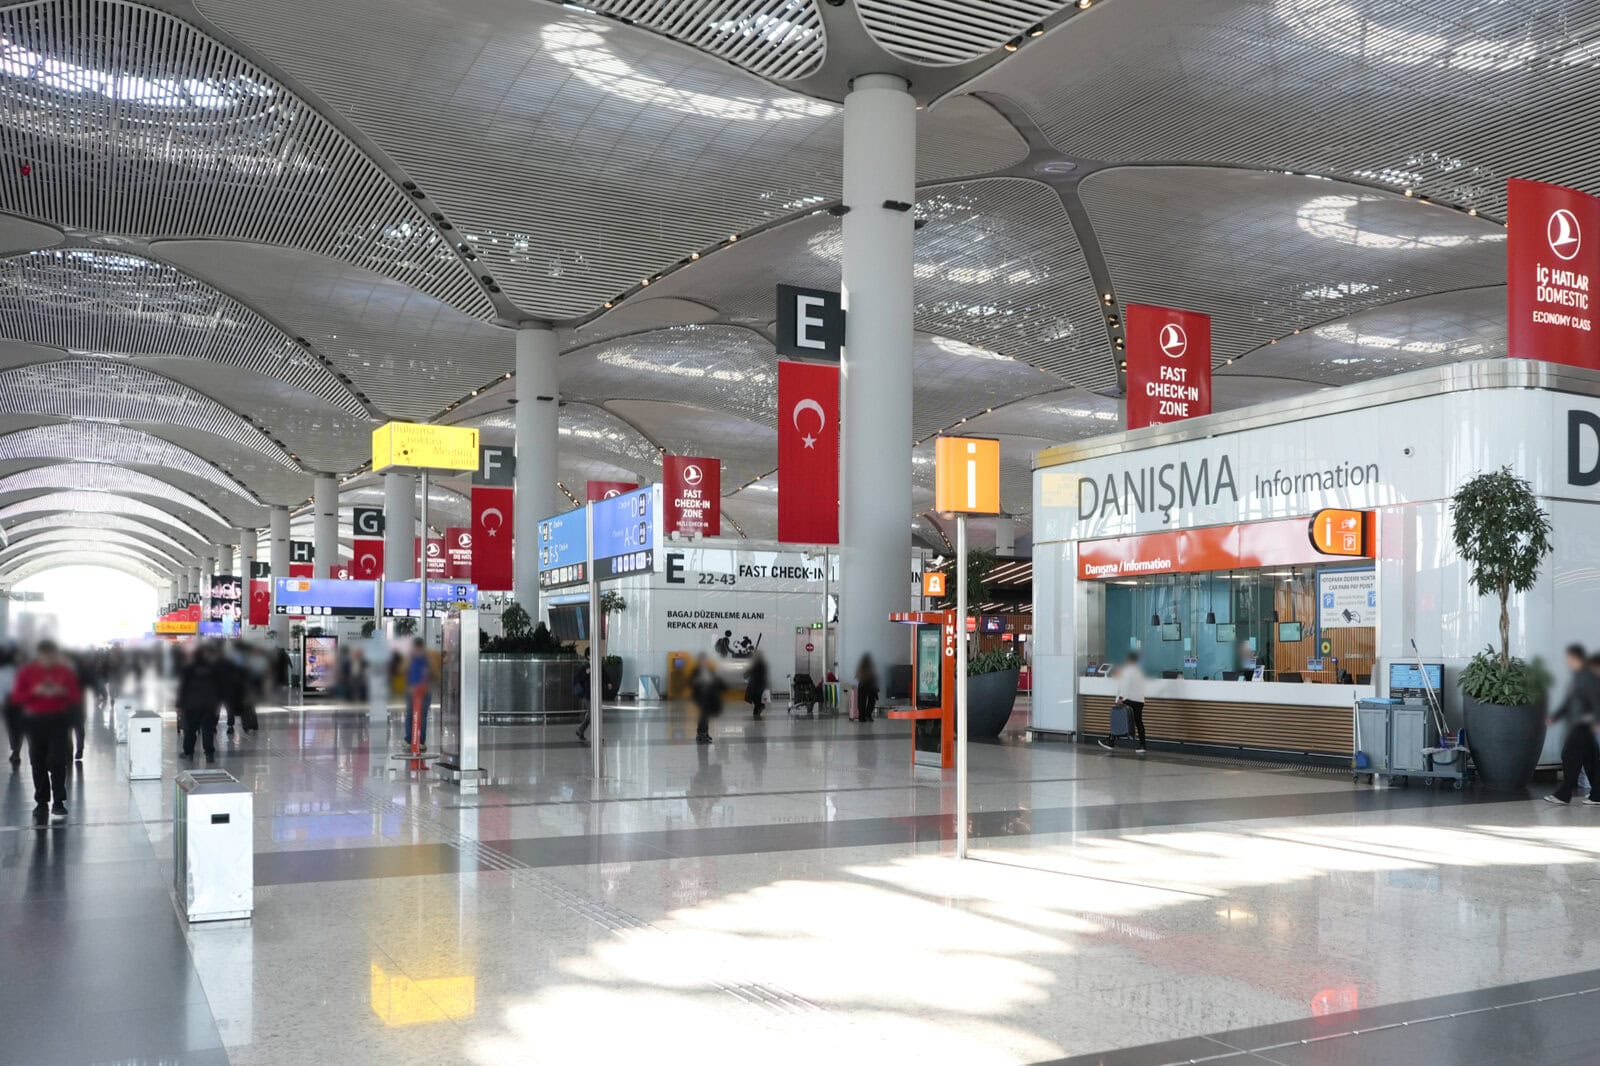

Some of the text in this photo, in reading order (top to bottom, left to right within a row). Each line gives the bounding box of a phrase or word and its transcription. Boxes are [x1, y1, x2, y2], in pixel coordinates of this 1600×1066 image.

[1536, 263, 1589, 291] İÇ HATLAR
[1537, 286, 1589, 309] DOMESTIC
[796, 294, 825, 350] E
[1532, 311, 1591, 331] ECONOMY CLASS
[1160, 365, 1187, 382] FAST
[1146, 382, 1199, 401] CHECK-IN
[1159, 400, 1189, 417] ZONE
[1568, 410, 1600, 487] D
[484, 449, 502, 480] F
[683, 489, 702, 498] FAST
[1077, 454, 1380, 524] DANIŞMA Information
[674, 498, 711, 509] CHECK-IN
[682, 509, 703, 518] ZONE
[359, 511, 378, 533] G
[294, 543, 309, 560] H
[255, 563, 264, 577] J
[666, 553, 686, 583] E
[1123, 557, 1171, 572] Information
[698, 573, 736, 585] 22-43
[739, 565, 767, 578] FAST
[667, 610, 692, 618] BAGAJ
[694, 610, 740, 619] DÜZENLEME
[945, 614, 954, 656] INFO
